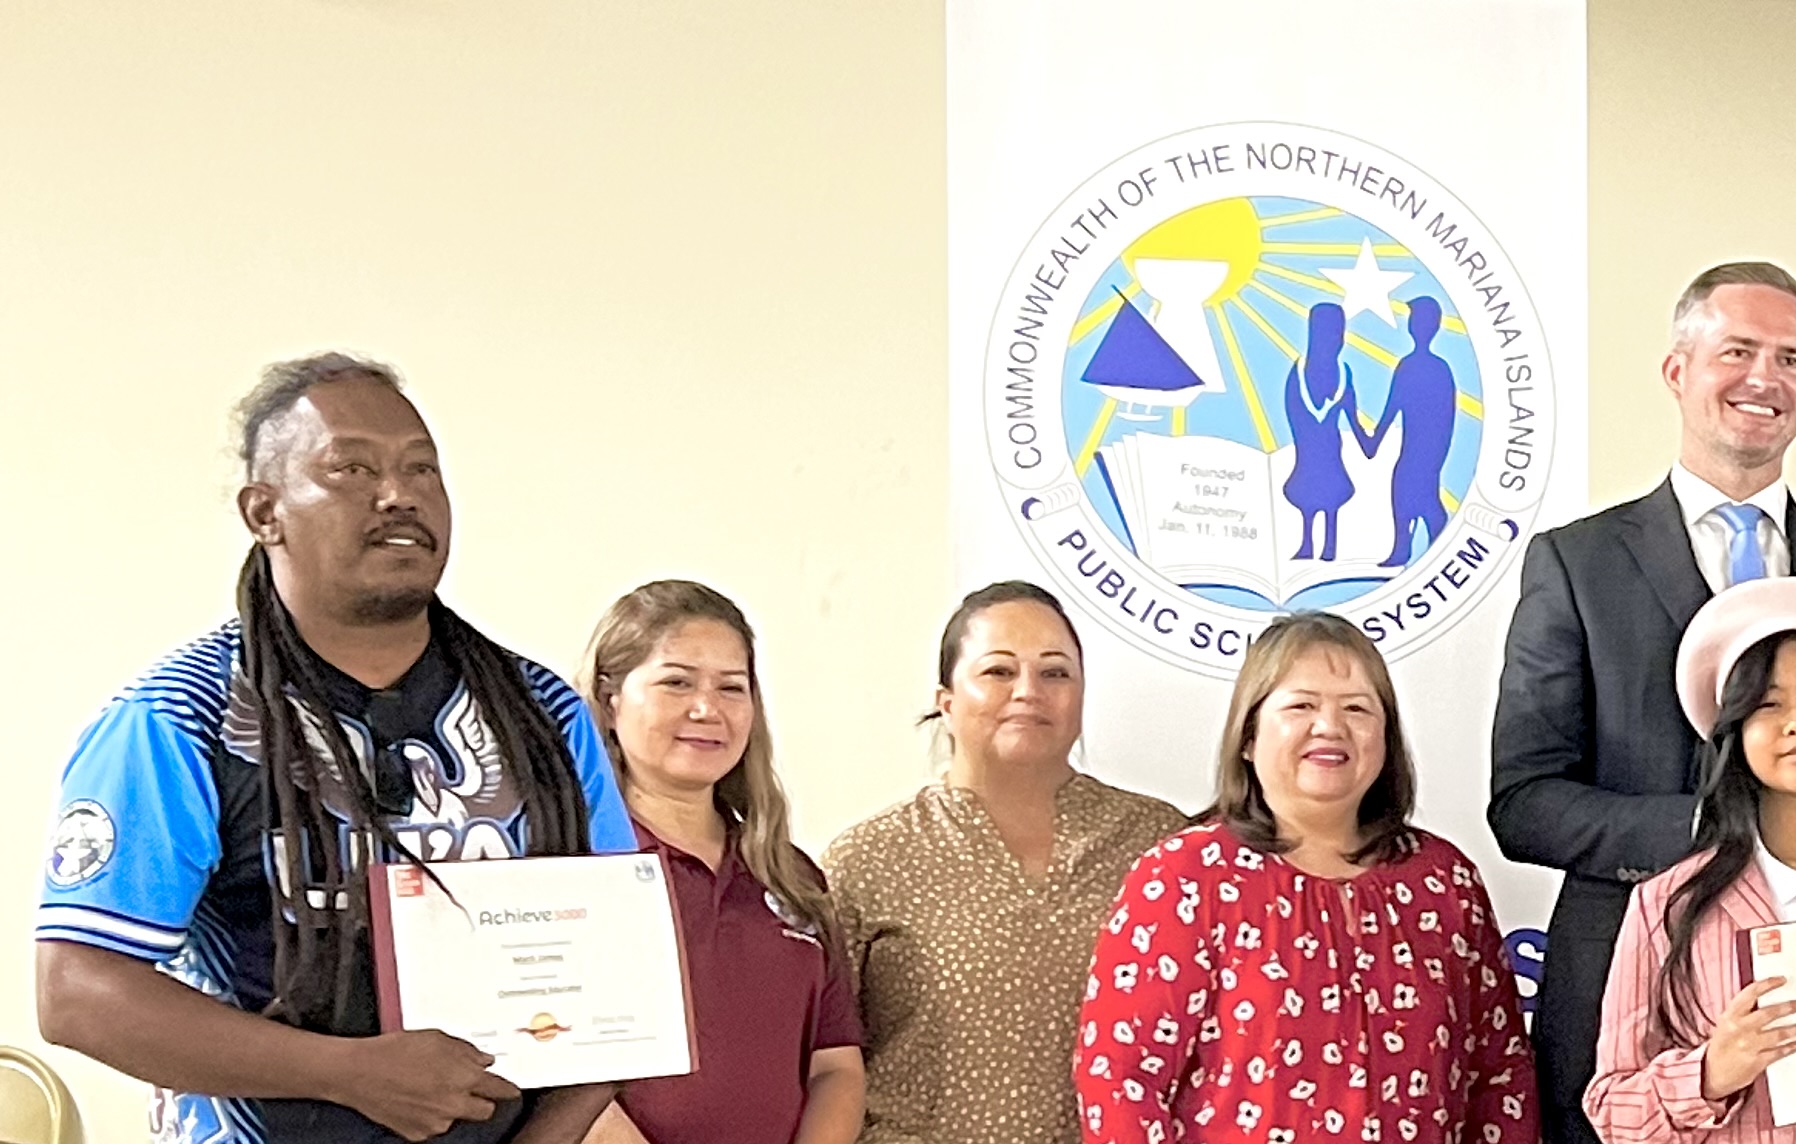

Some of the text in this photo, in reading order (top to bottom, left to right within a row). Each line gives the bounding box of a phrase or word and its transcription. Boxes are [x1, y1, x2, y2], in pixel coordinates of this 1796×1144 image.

[1005, 142, 1536, 492] COMMONWEALTH OF THE NORTHERN MARIANA ISLANDS
[1180, 463, 1246, 482] Founded
[1194, 484, 1230, 498] 1947
[1171, 500, 1248, 522] Autonomy
[1057, 528, 1490, 643] PUBLIC SYSTEM
